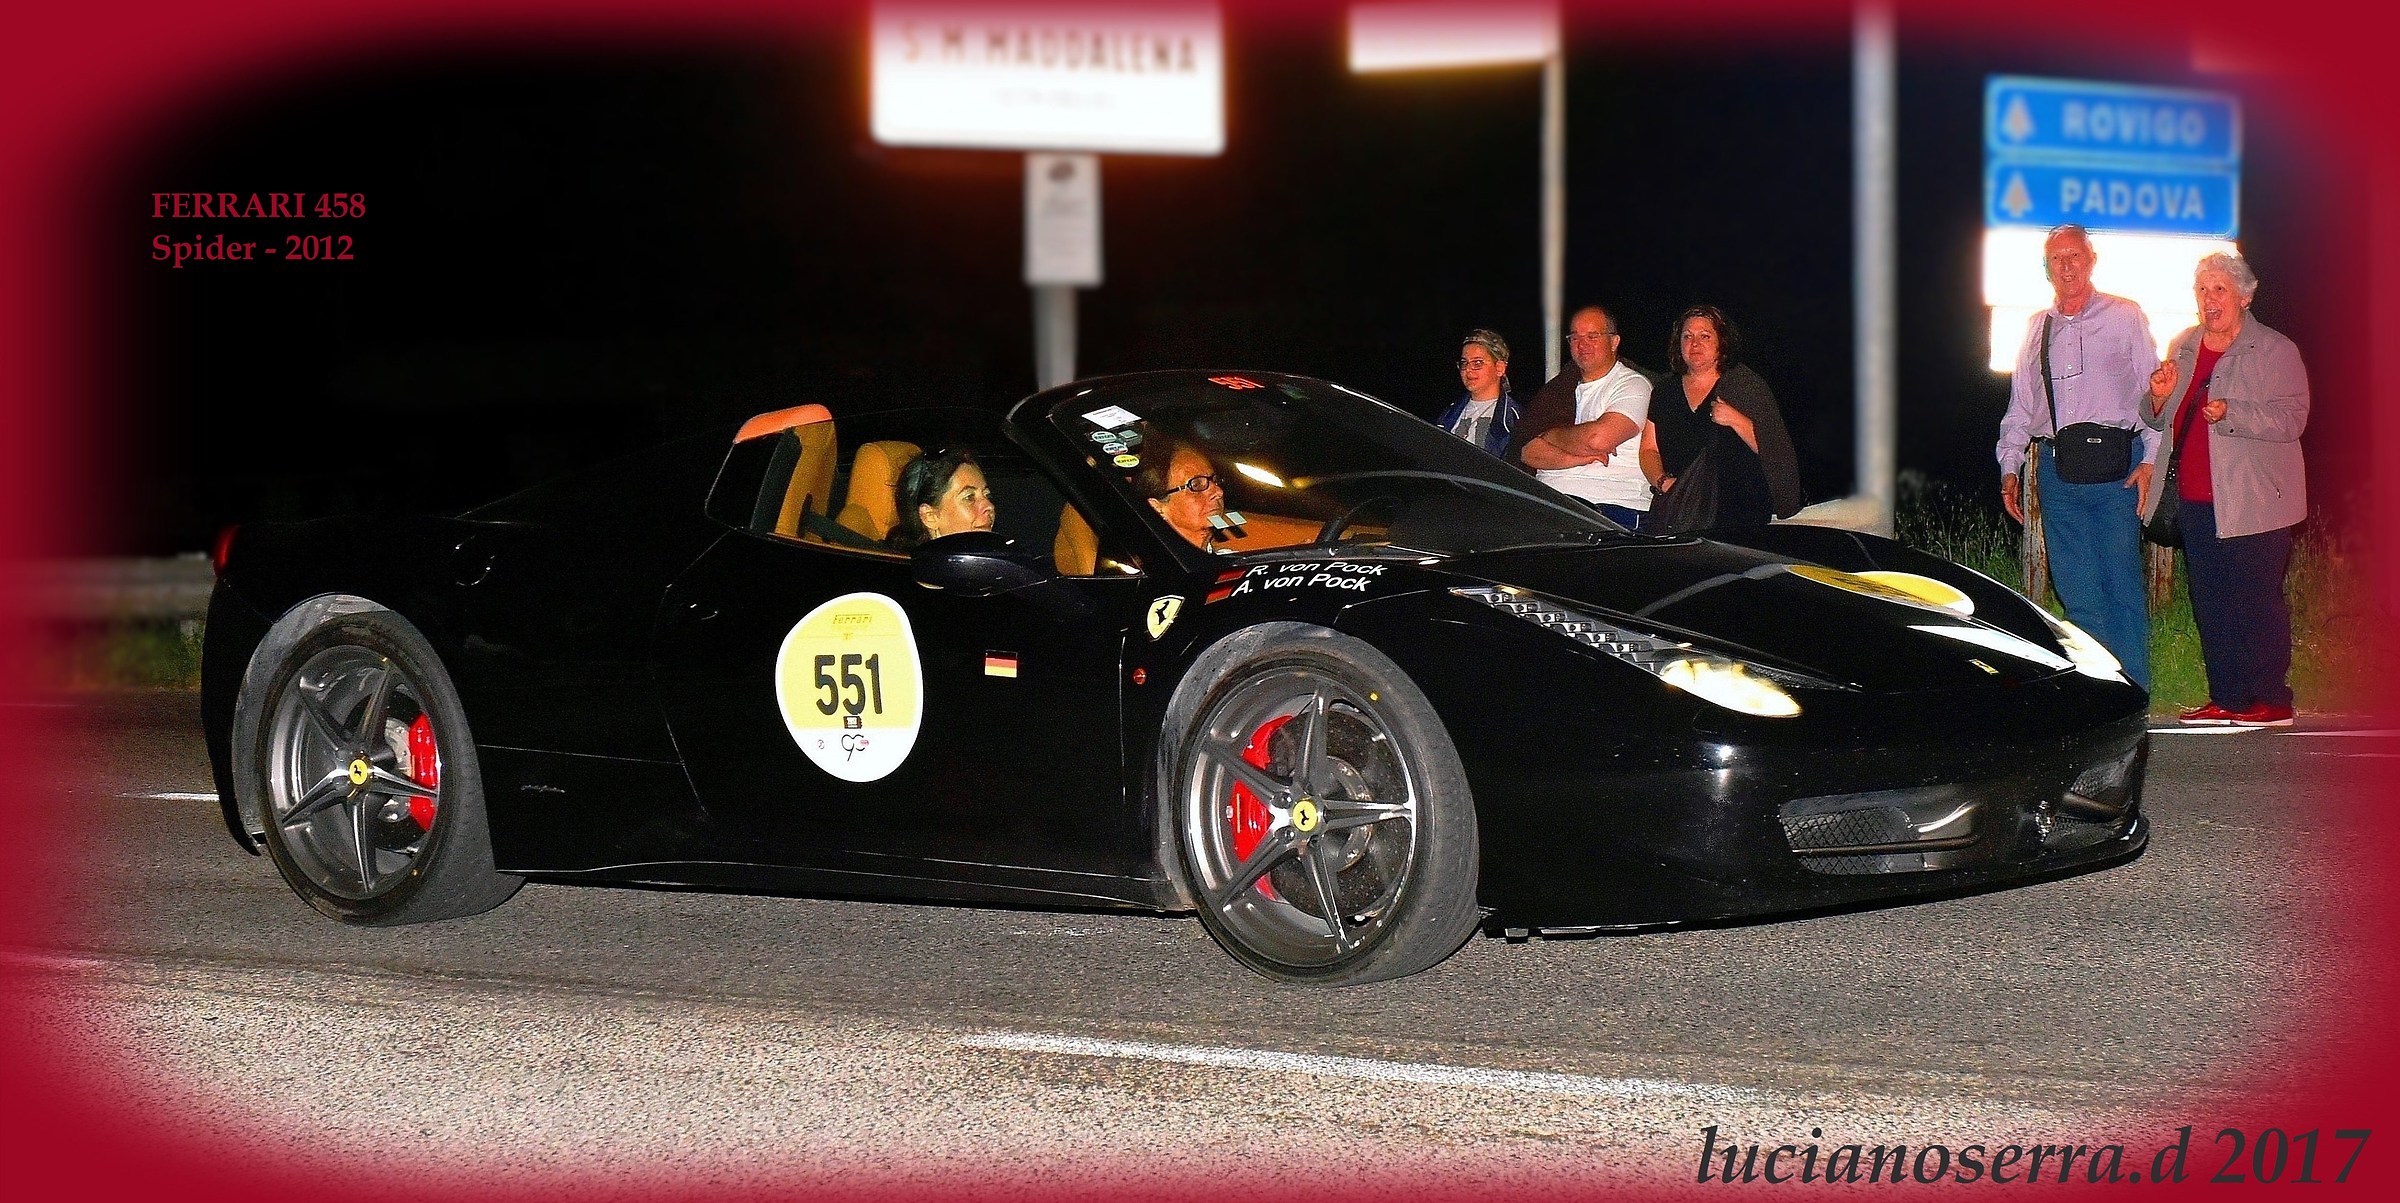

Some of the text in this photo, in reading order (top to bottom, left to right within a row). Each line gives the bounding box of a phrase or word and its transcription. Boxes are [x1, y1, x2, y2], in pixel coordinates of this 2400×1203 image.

[2062, 102, 2206, 146] ROVIGO
[2060, 179, 2205, 220] PADOVA
[1231, 573, 1372, 597] A. von Pock
[1246, 561, 1388, 577] R. von Pock
[814, 653, 883, 716] 551
